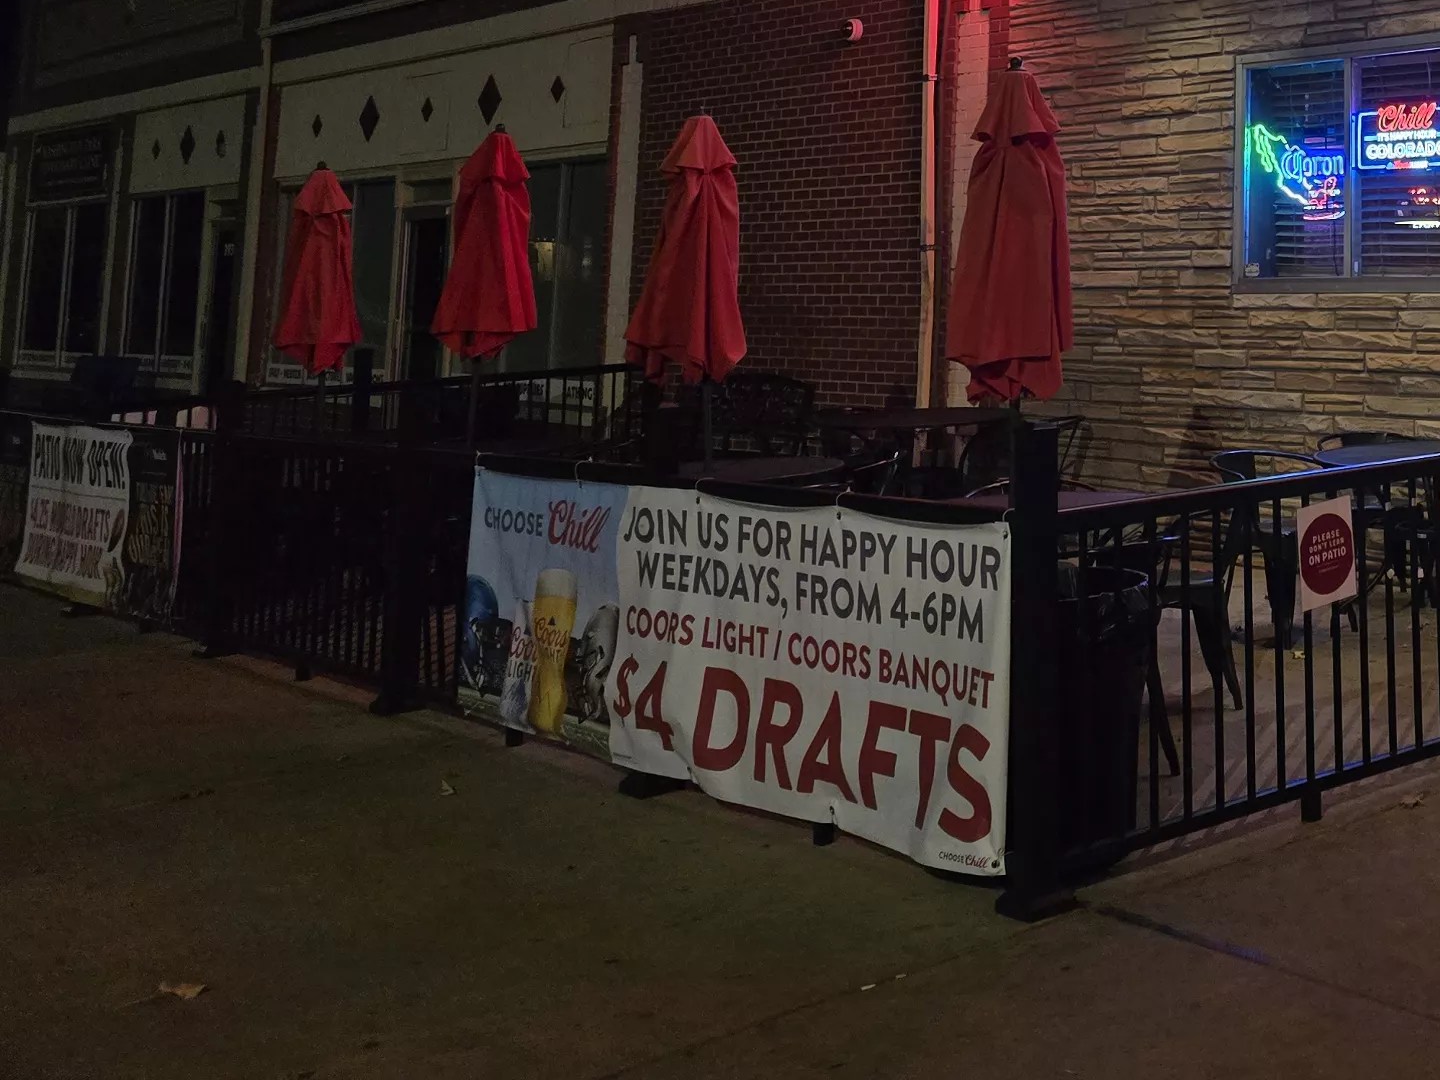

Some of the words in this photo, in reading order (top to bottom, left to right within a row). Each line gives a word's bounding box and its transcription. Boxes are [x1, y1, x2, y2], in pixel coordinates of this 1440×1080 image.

[1378, 102, 1436, 132] Chill
[1281, 149, 1345, 183] Coron
[484, 506, 544, 537] CHOOSE
[548, 500, 612, 553] Chill
[1312, 529, 1340, 544] PLEASE
[623, 506, 688, 547] JOIN
[697, 511, 729, 551] US
[737, 516, 792, 560] FOR
[800, 523, 897, 575] HAPPY
[906, 536, 1001, 591] HOUR
[1308, 554, 1320, 566] ON
[1322, 546, 1347, 561] PATIO
[636, 550, 788, 619] WEEKDAYS,
[796, 572, 882, 624] FROM
[890, 587, 984, 643] 4-6PM
[510, 626, 537, 662] Coo
[626, 605, 695, 645] COORS
[701, 617, 769, 658] LIGHT
[788, 632, 871, 680] COORS
[879, 648, 995, 709] BANQUET
[507, 658, 533, 682] LIGH
[613, 653, 674, 752] $4
[692, 667, 992, 843] DRAFTS
[938, 851, 964, 864] CHOOSE
[965, 854, 990, 868] Chill
